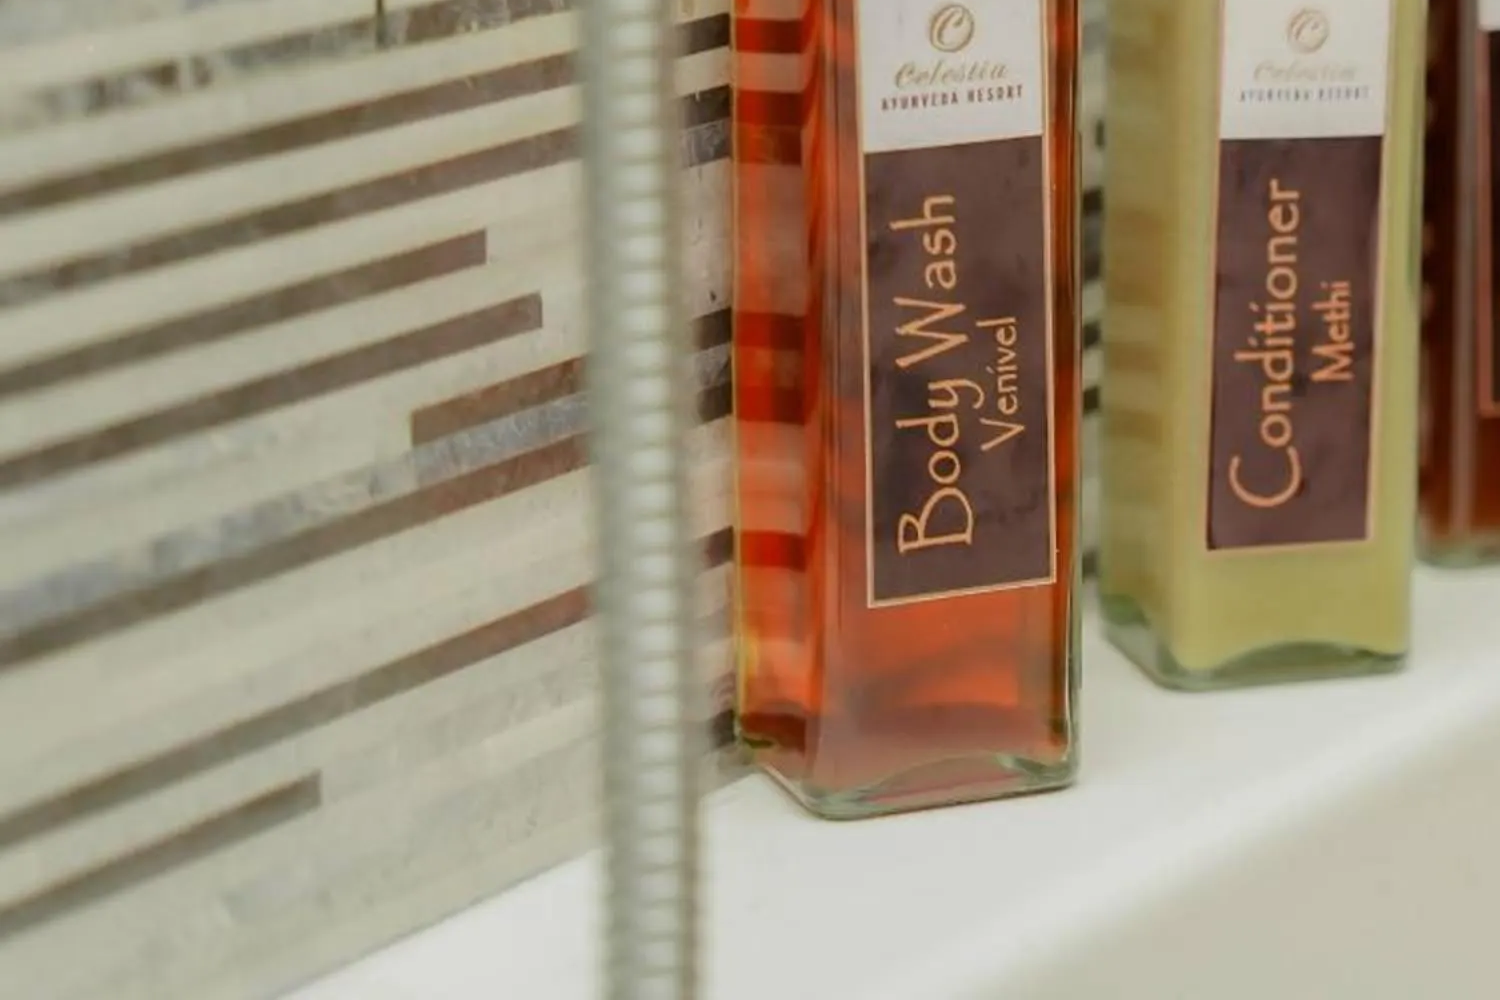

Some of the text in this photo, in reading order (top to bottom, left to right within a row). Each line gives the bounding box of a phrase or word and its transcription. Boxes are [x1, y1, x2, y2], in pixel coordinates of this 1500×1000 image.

[880, 83, 1024, 112] AYURVEDA RESORT
[888, 193, 985, 554] Body Wash
[1228, 178, 1302, 508] Conditioner
[1310, 280, 1355, 383] Methi
